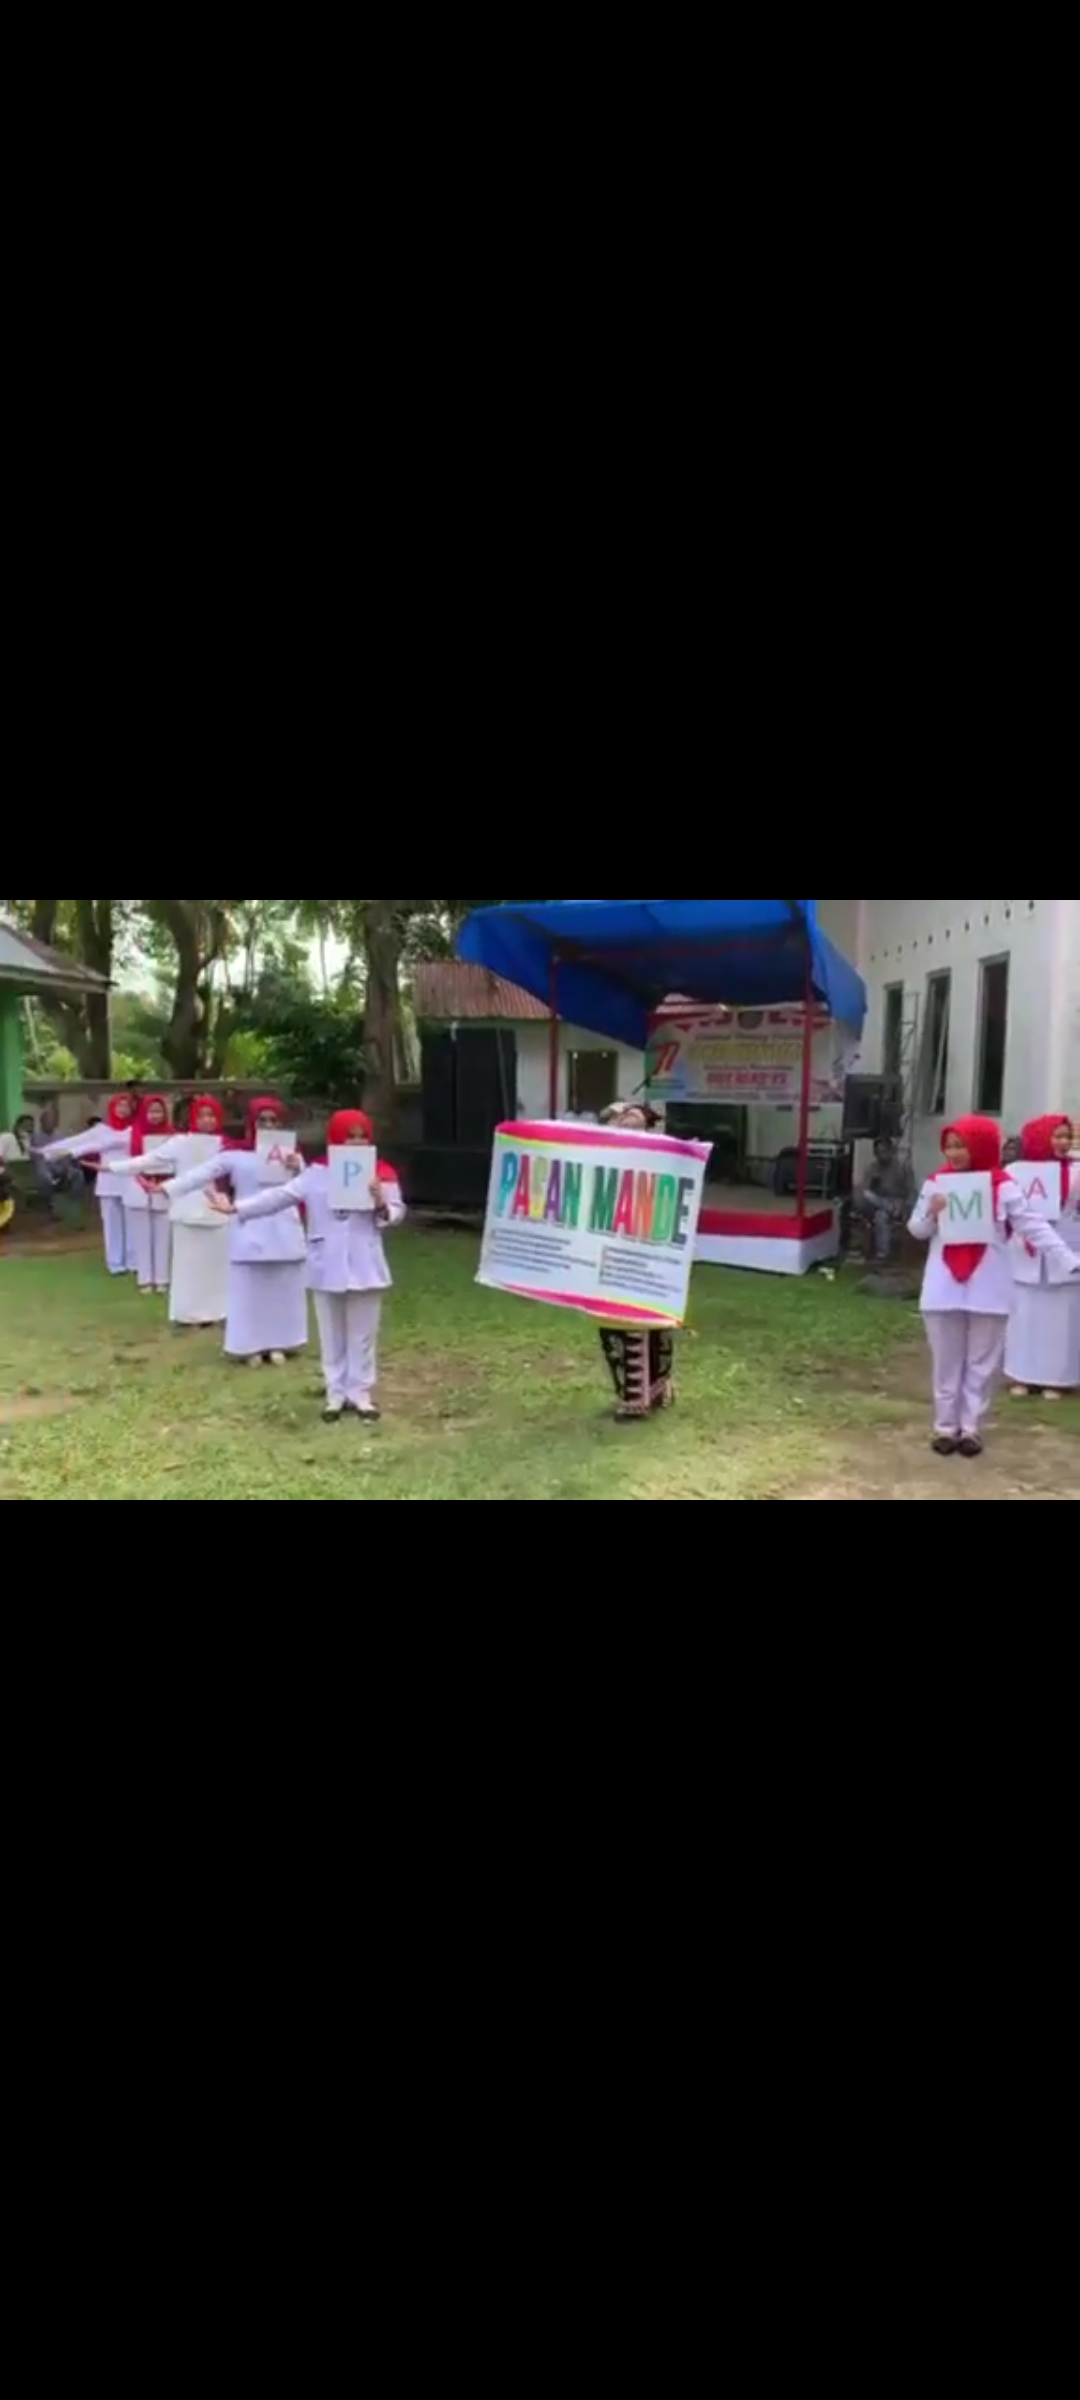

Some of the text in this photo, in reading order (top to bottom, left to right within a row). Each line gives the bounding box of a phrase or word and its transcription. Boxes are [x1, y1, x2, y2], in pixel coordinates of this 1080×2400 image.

[265, 1144, 283, 1166] A
[343, 1160, 363, 1187] P
[495, 1151, 695, 1248] PASAN MANDE
[1027, 1177, 1048, 1200] A
[948, 1190, 983, 1221] M
